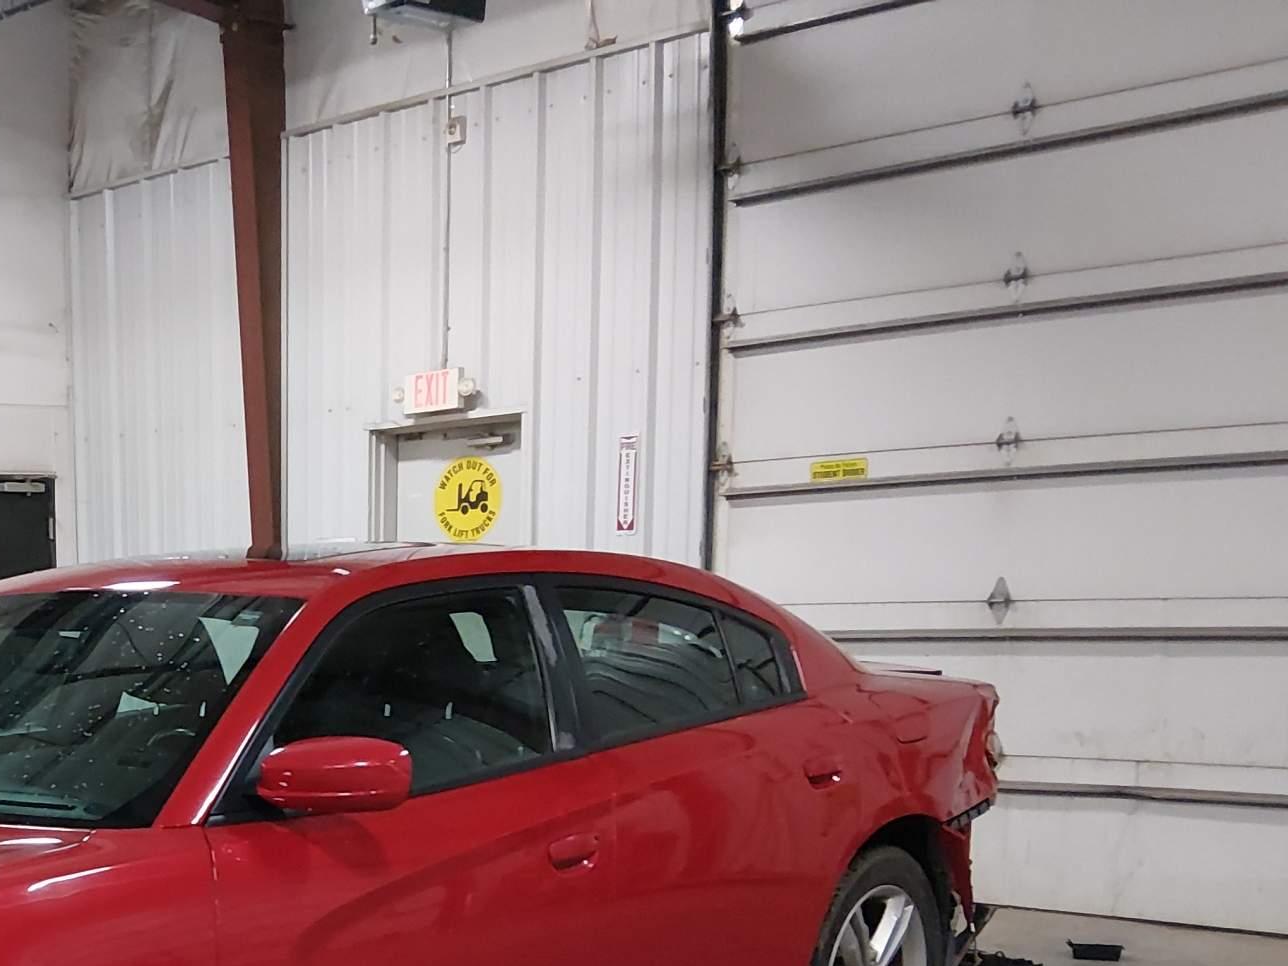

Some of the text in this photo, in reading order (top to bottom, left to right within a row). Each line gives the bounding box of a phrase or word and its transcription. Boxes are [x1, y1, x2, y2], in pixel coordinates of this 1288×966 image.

[414, 371, 449, 408] EXIT
[438, 459, 497, 490] WATCH OUT FOR
[438, 510, 496, 539] FORK LIFT TRUCKS
